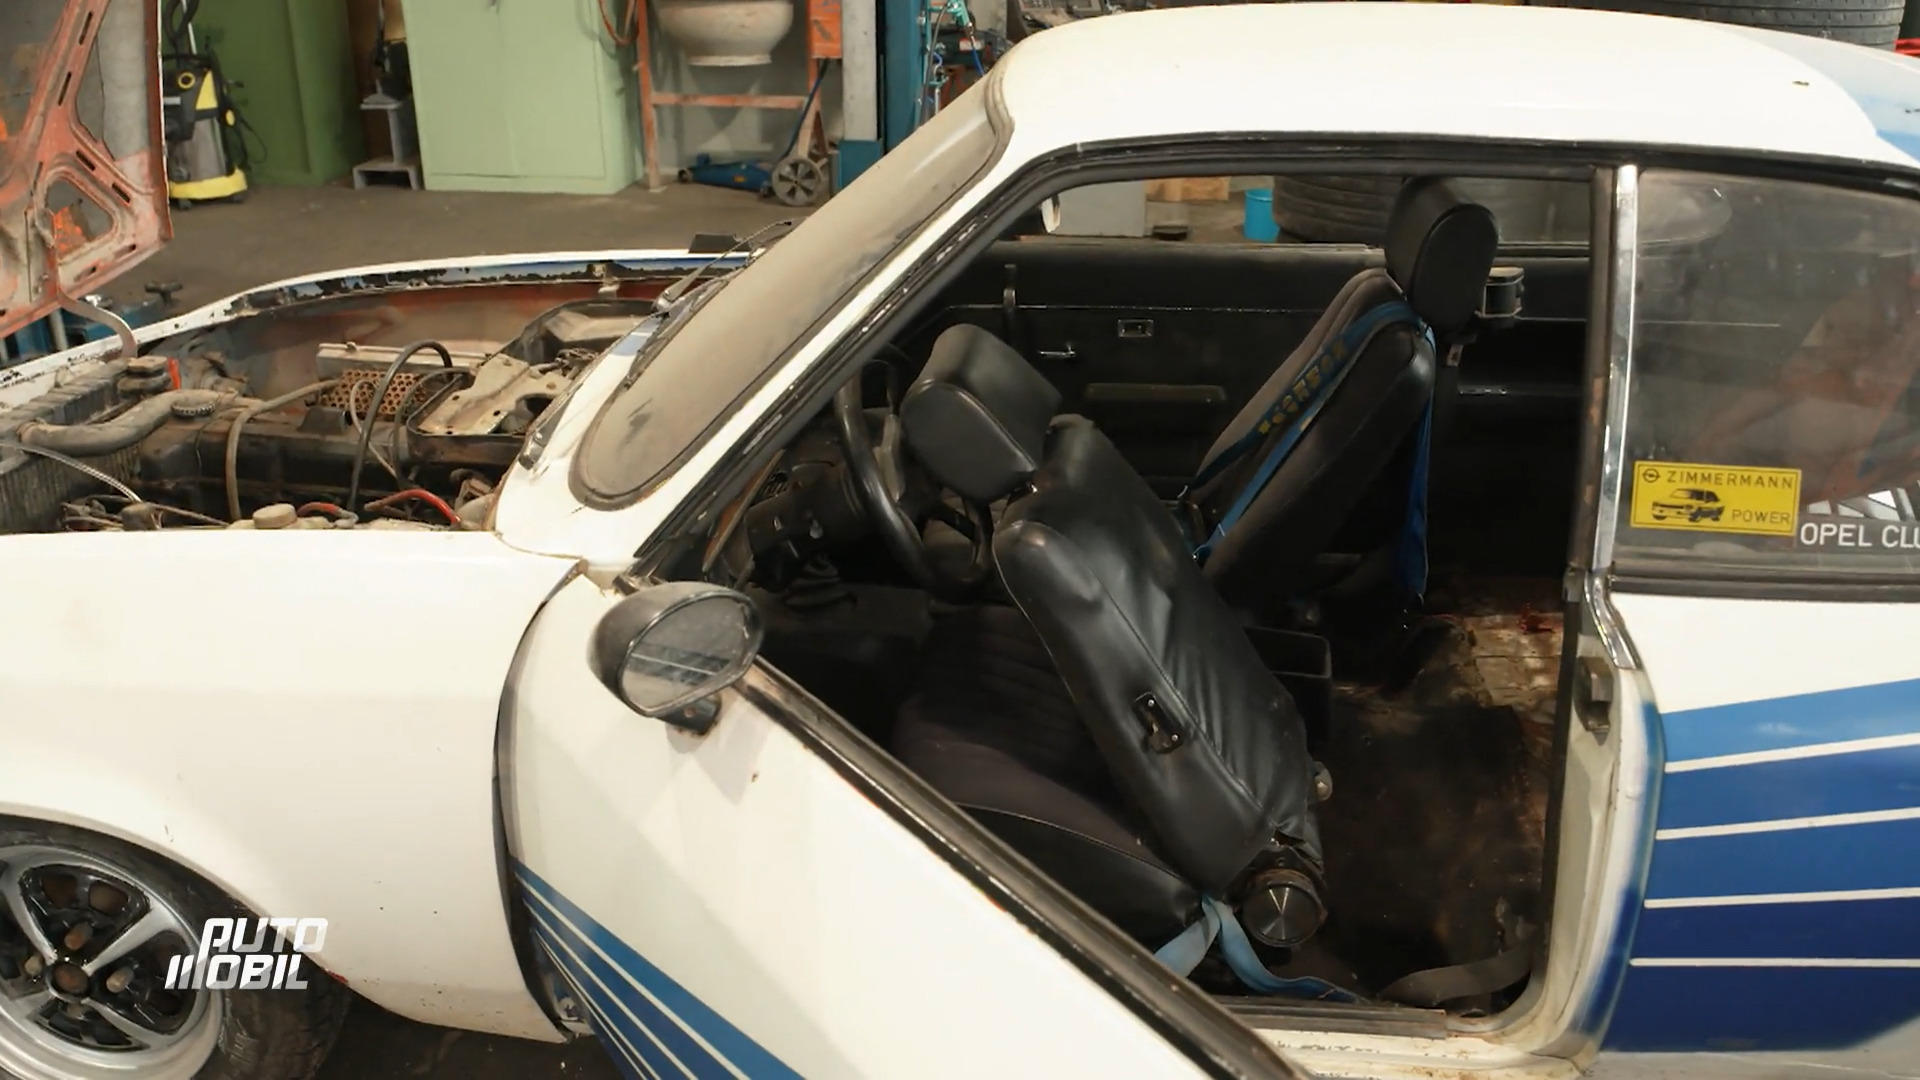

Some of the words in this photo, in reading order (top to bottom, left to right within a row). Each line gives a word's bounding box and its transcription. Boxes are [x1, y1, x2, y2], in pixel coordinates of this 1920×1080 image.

[1667, 470, 1793, 489] ZIMMERMANN
[1732, 509, 1791, 525] POWER
[1800, 522, 1873, 547] OPEL
